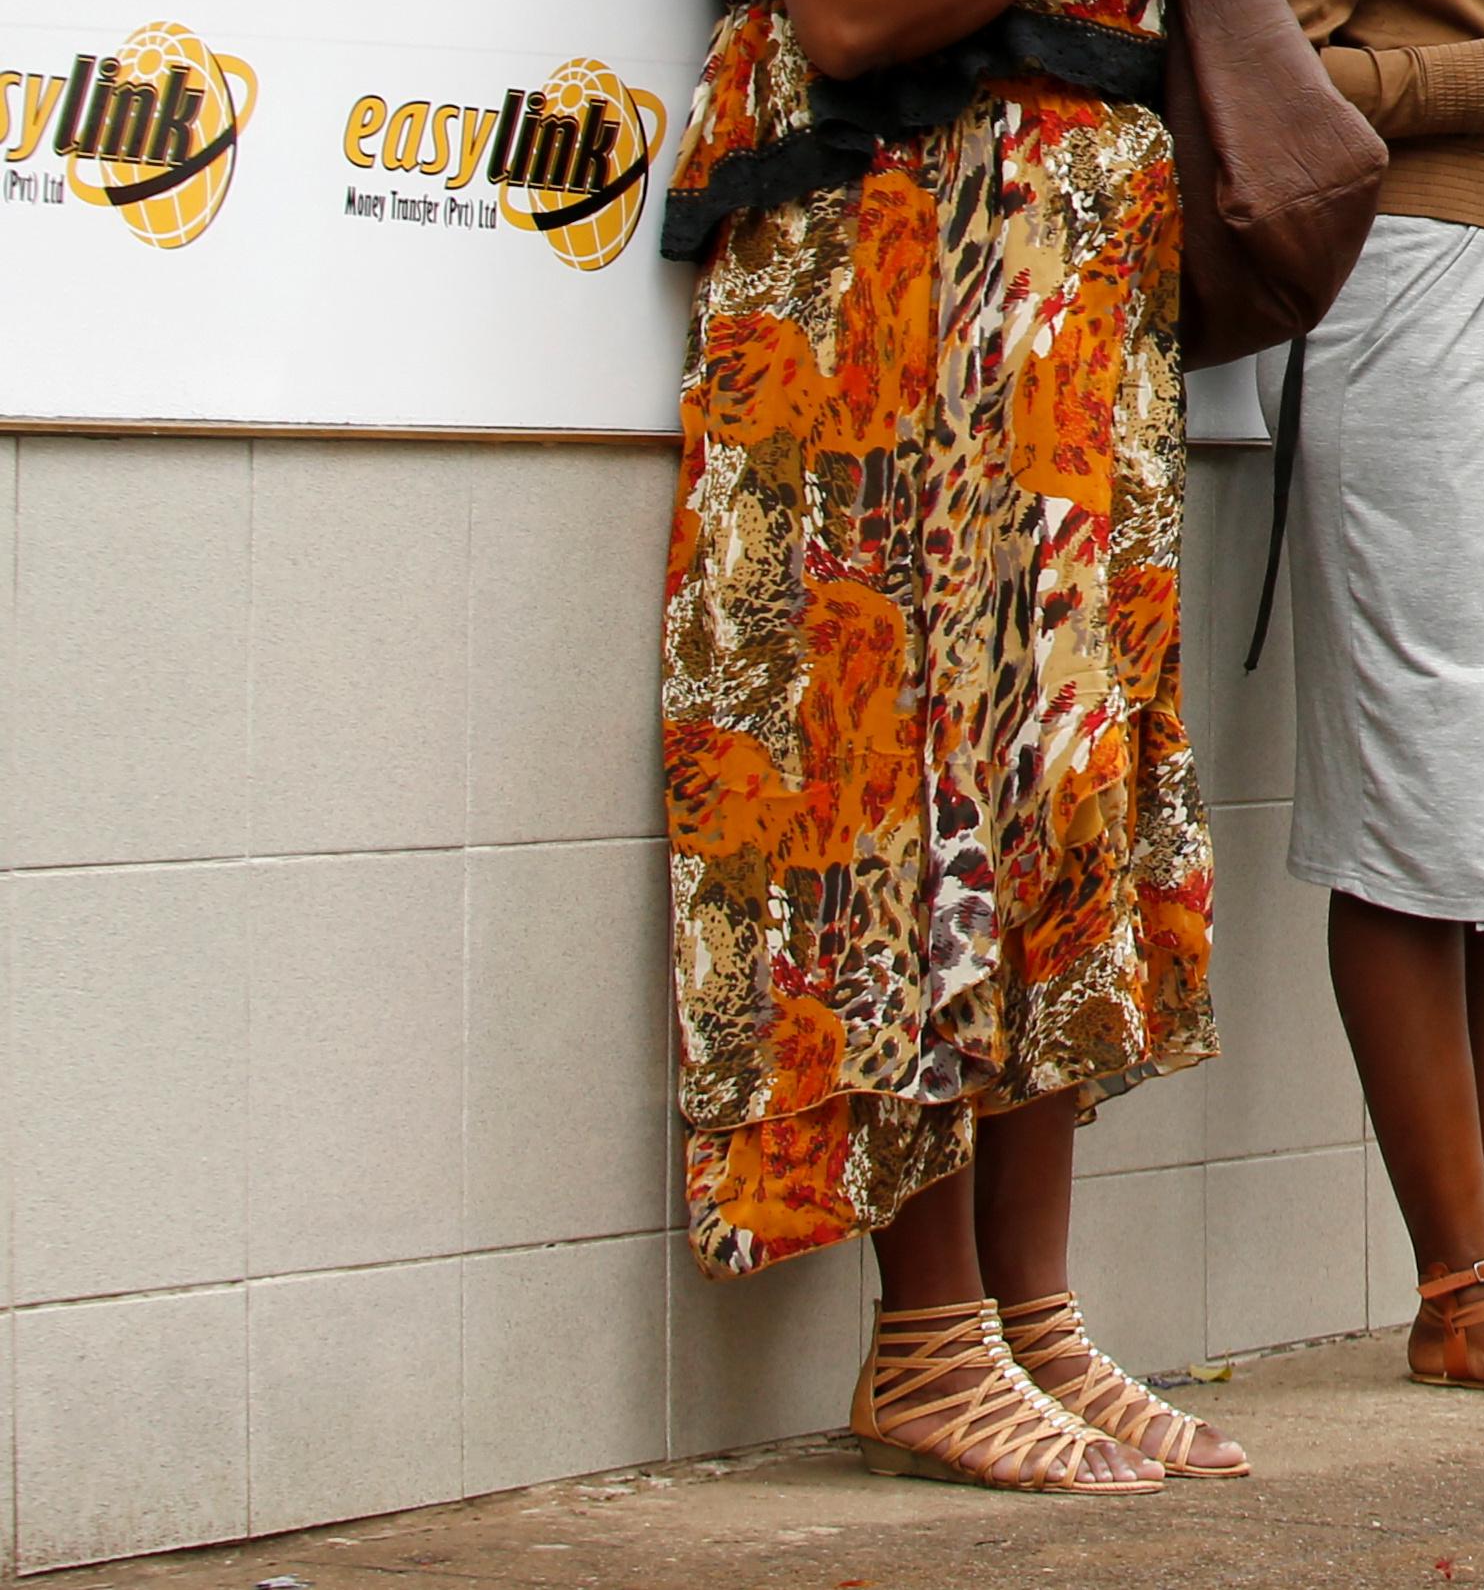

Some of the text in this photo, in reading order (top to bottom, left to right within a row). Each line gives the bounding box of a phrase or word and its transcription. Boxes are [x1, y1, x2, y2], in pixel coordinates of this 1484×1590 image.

[342, 88, 621, 195] easylink
[3, 169, 65, 205] (Pvt) Ltd
[344, 185, 498, 230] Money Transfer (Pvt) Ltd
